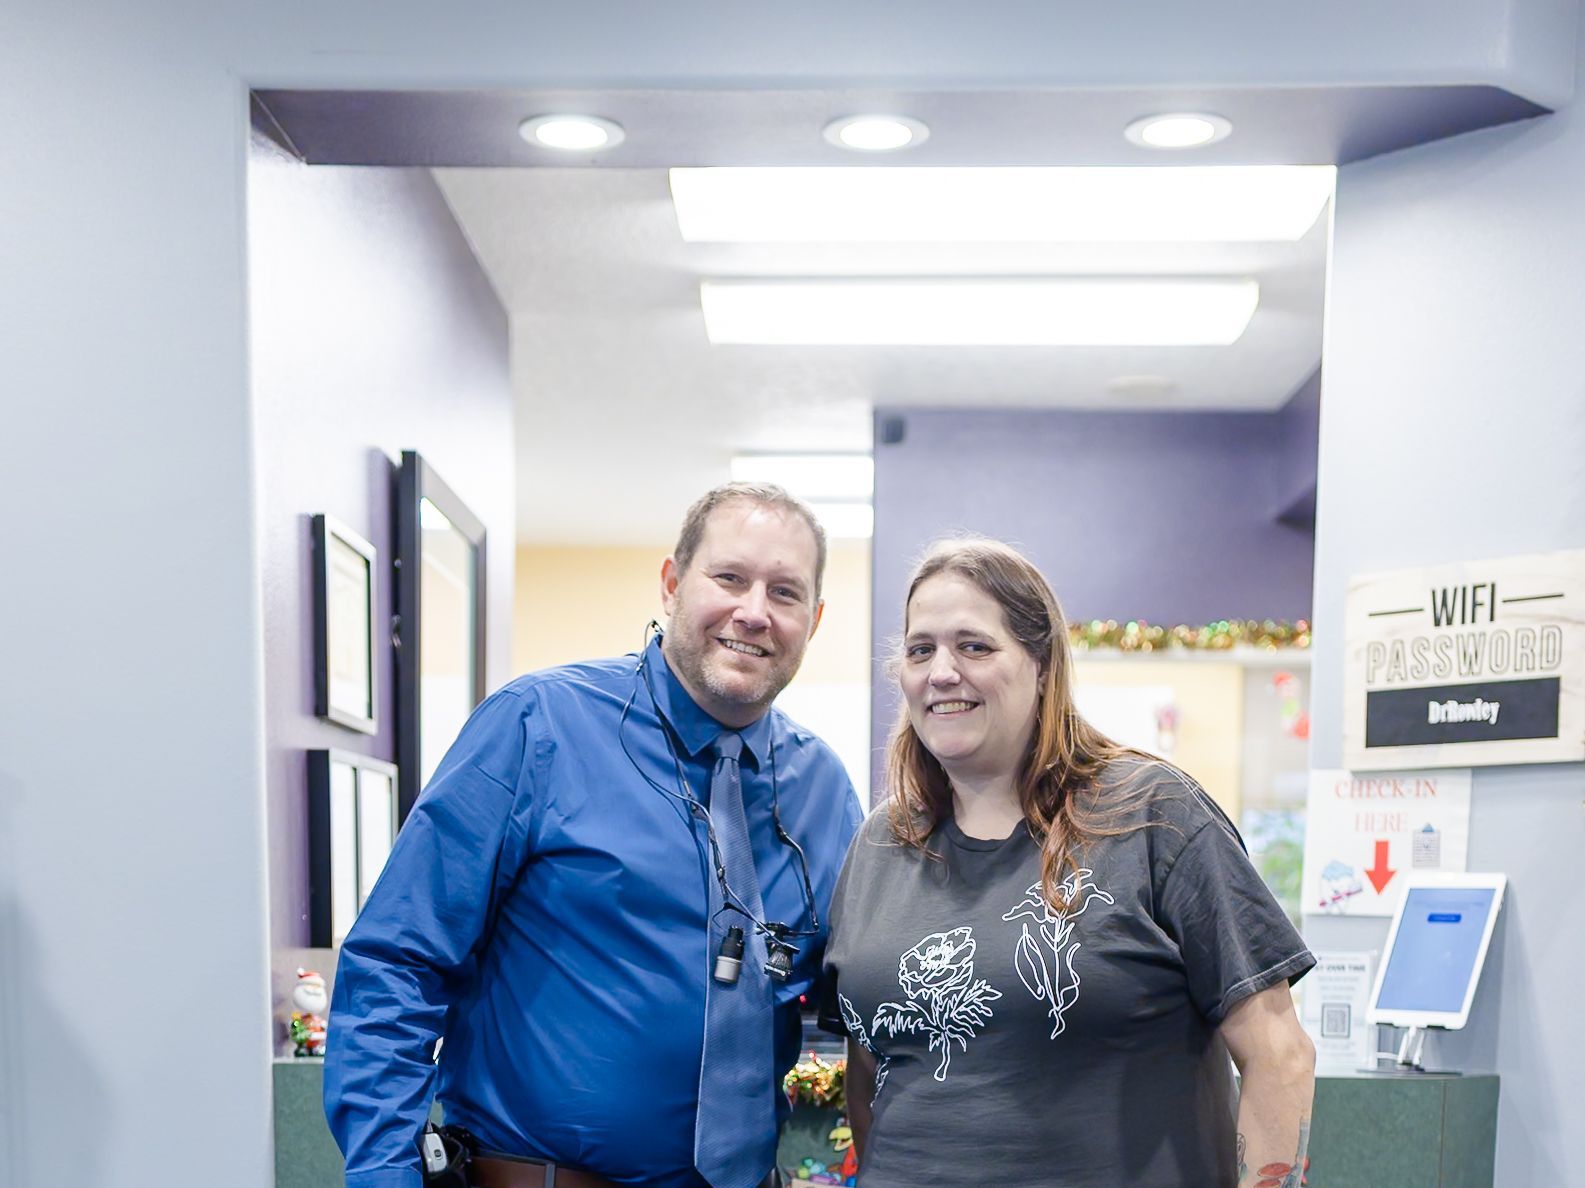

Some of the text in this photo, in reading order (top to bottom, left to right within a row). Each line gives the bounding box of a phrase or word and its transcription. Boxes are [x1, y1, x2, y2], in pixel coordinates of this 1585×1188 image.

[1431, 582, 1496, 627] WIFI
[1366, 624, 1563, 684] PASSWORD
[1334, 777, 1438, 799] CHECK-IN
[1353, 811, 1409, 833] HERE
